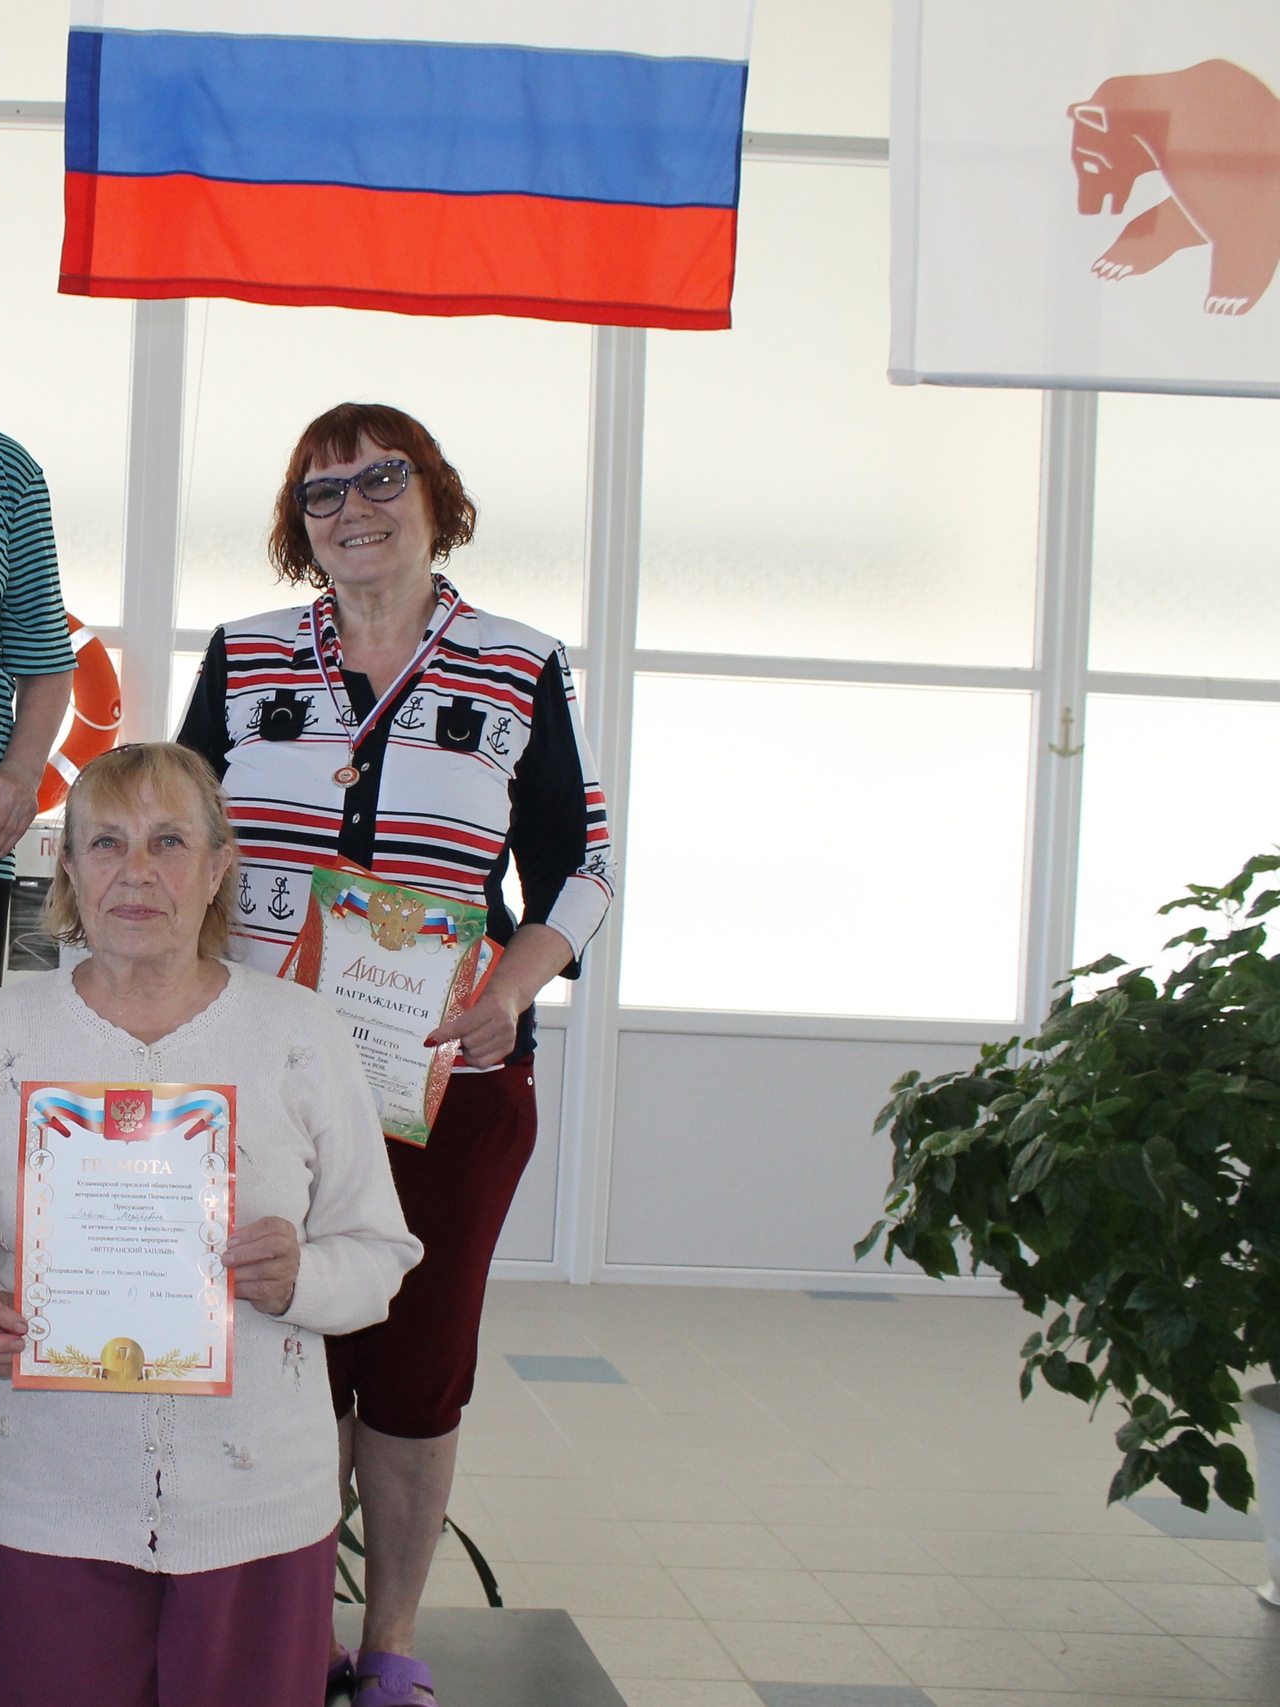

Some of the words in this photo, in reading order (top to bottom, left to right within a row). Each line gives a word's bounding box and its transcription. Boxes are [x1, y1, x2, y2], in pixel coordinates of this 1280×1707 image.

[335, 986, 429, 1019] НАГРАЖДАЕТСЯ
[352, 1026, 370, 1041] III
[372, 1037, 400, 1049] МЕСТО
[81, 1158, 173, 1175] ГРАМОТА
[76, 1180, 119, 1189] Кудымкарской
[148, 1193, 180, 1201] Пермского
